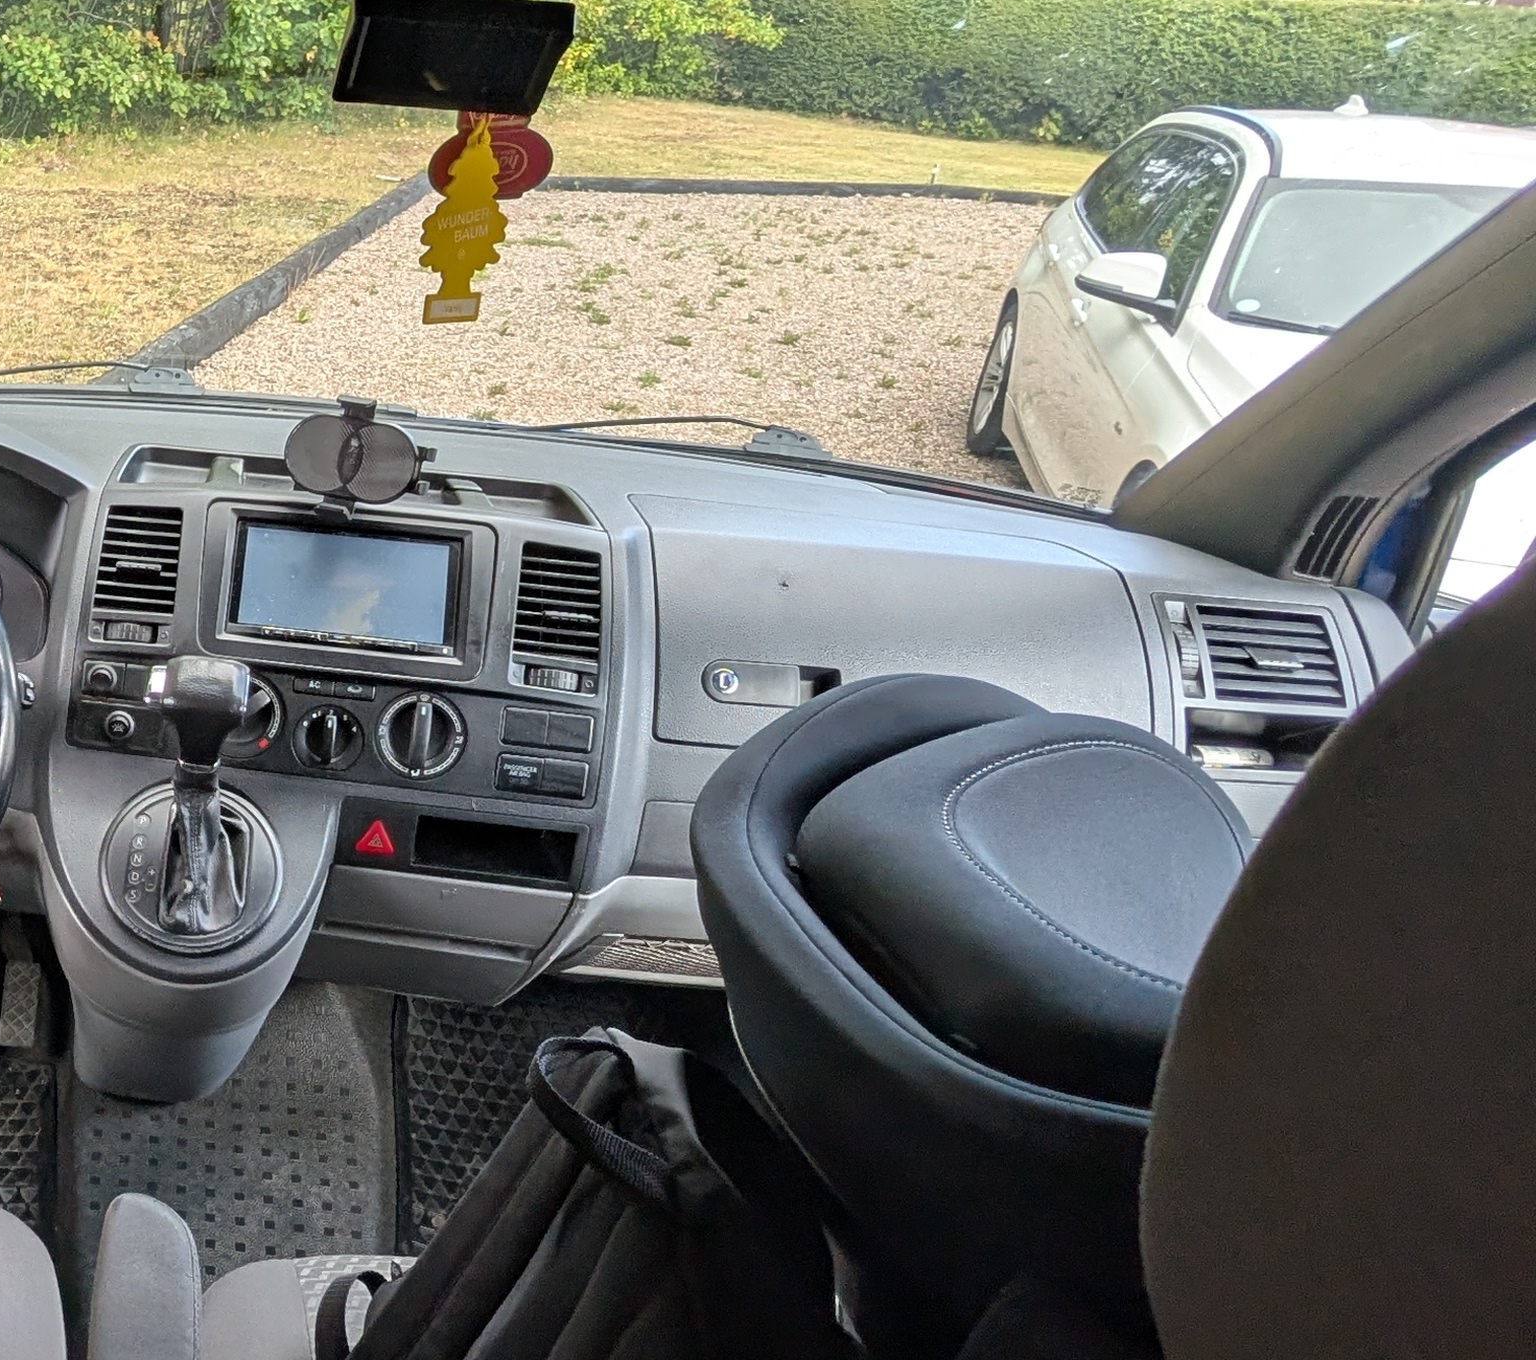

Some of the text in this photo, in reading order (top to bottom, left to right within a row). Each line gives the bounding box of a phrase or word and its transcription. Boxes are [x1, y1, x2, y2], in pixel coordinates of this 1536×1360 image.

[437, 207, 494, 230] WUNDER-
[454, 223, 489, 243] BAUM
[308, 680, 321, 689] AC
[139, 816, 147, 825] P
[136, 837, 143, 847] R
[133, 854, 142, 863] N
[131, 871, 140, 879] D
[130, 889, 137, 899] S
